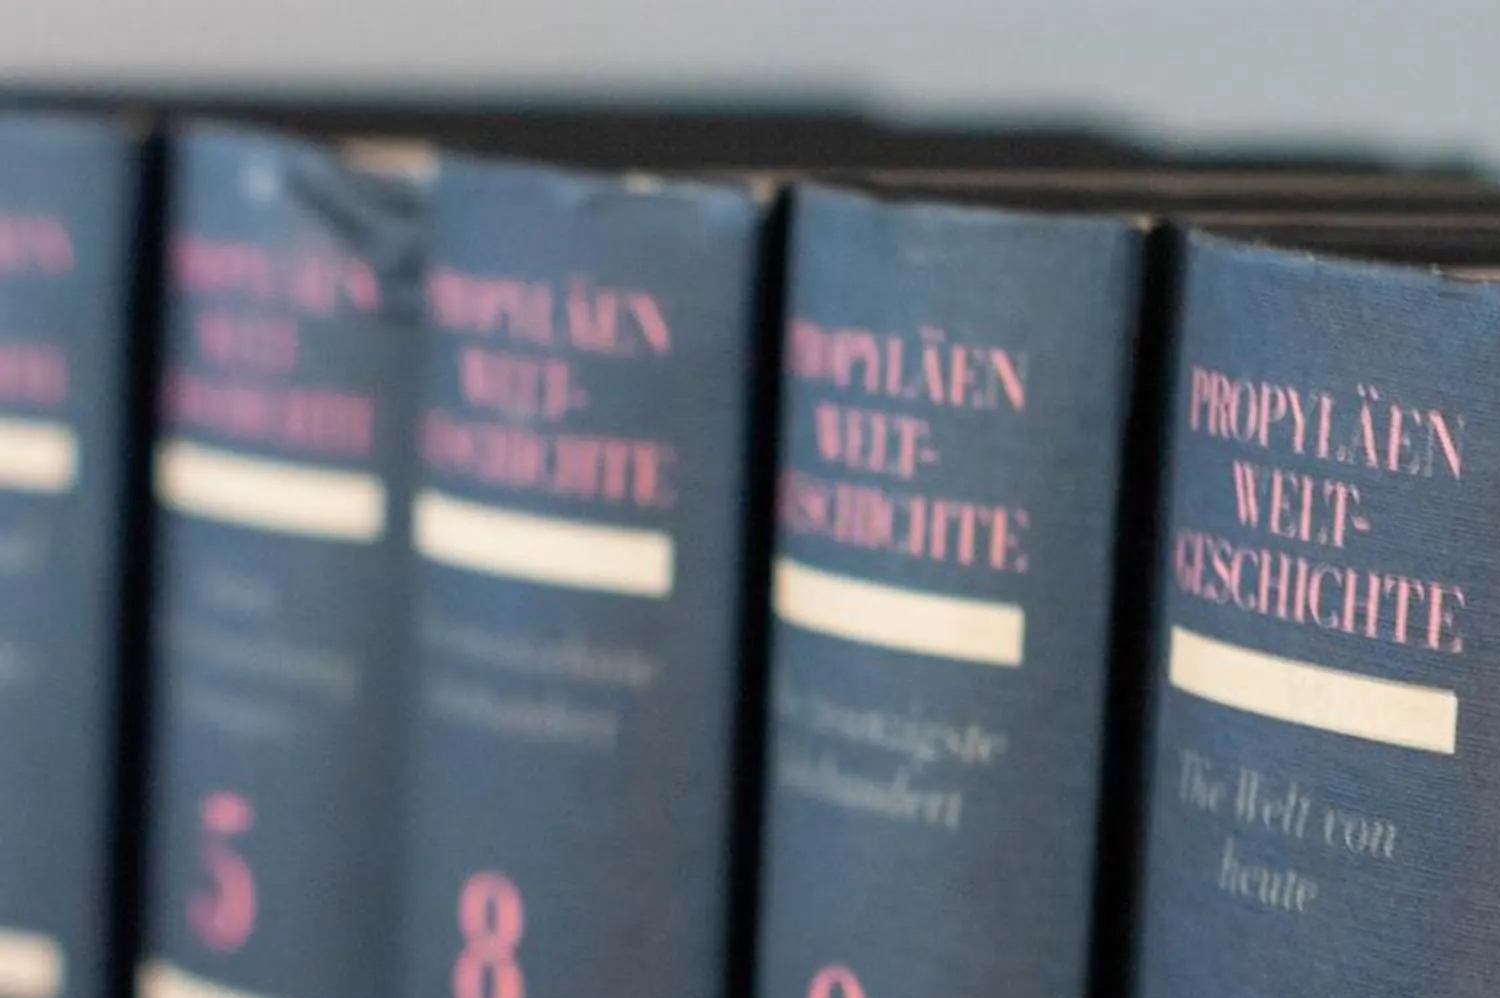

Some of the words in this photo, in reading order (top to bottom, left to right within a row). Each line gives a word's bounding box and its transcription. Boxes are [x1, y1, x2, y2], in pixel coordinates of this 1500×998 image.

[1189, 364, 1465, 480] PROPYLÄEN
[1232, 459, 1373, 549] WELT-
[1172, 529, 1466, 655] GESCHICHTE
[1235, 766, 1311, 840] Welt
[1324, 806, 1398, 862] von
[187, 790, 257, 956] 5
[1219, 836, 1319, 912] heute
